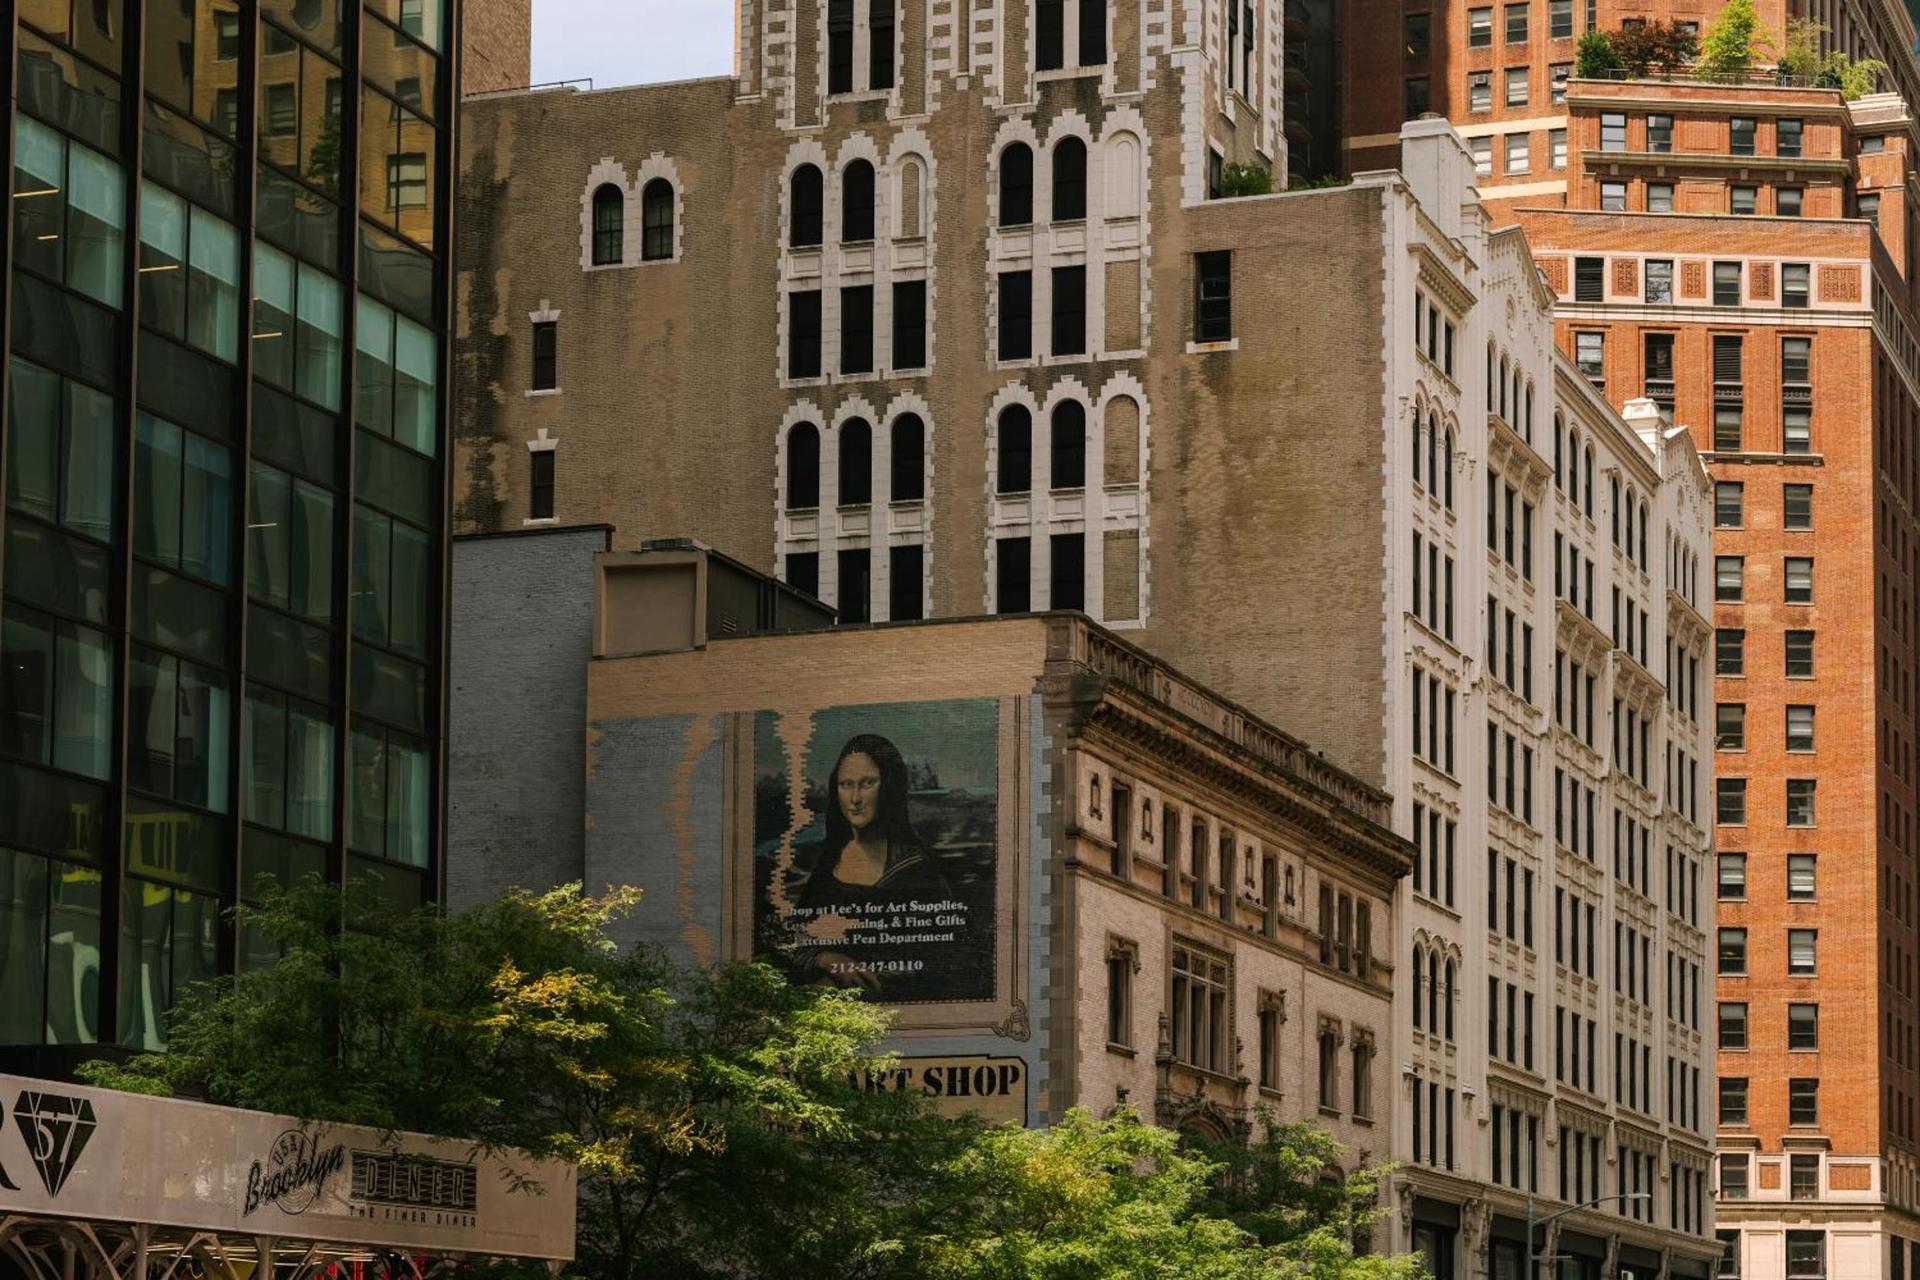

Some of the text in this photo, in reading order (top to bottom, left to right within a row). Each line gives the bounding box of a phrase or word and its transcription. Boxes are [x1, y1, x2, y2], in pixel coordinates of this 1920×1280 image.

[785, 900, 969, 917] hop at Lee's for Art Supplies,
[891, 916, 902, 927] &
[905, 916, 932, 928] Fine
[935, 914, 967, 927] Gifts
[853, 934, 876, 945] Pen
[879, 932, 954, 946] Department
[830, 959, 924, 974] 212-247-0110
[923, 1064, 1020, 1097] SHOP
[242, 1133, 345, 1218] Brooklyn
[365, 1157, 466, 1206] DINER
[350, 1205, 477, 1228] THE FINER DINER
